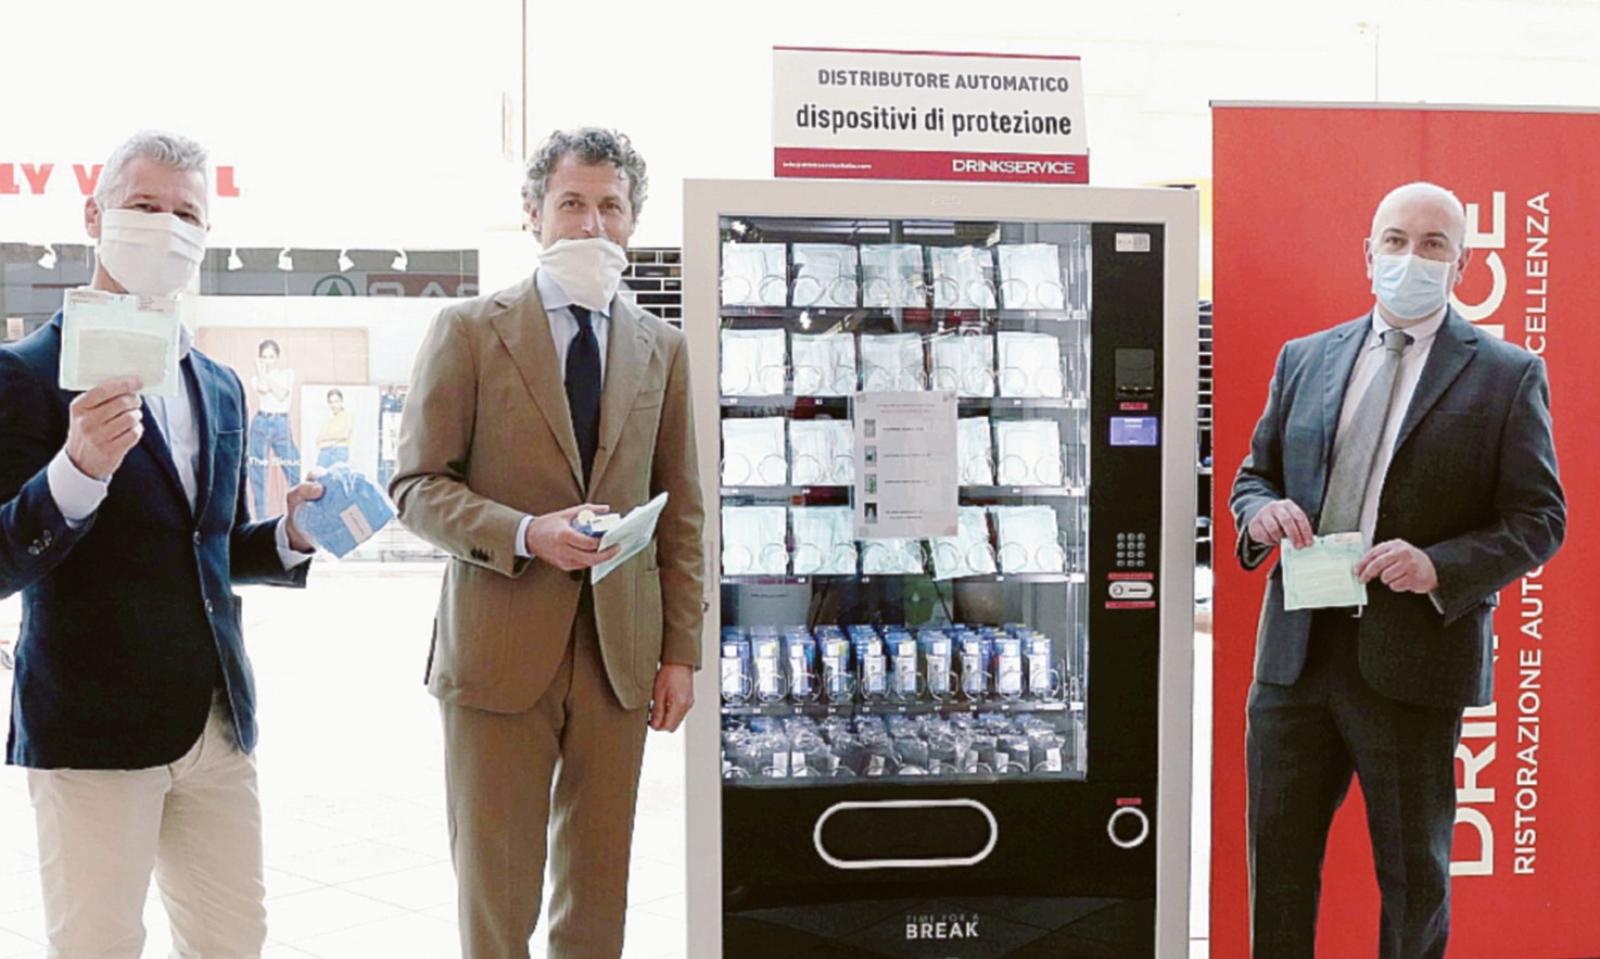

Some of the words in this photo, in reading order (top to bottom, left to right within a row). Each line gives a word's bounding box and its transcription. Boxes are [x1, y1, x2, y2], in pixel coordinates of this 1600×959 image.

[818, 68, 950, 89] DISTRIBUTORE
[955, 74, 1069, 93] AUTOMATICO
[796, 103, 917, 135] dispositivi
[924, 107, 945, 132] di
[952, 109, 1072, 138] protezione
[952, 158, 1076, 175] DRINKSERVICE
[1514, 648, 1543, 875] RISTORAZIONE
[905, 921, 979, 940] BREAK
